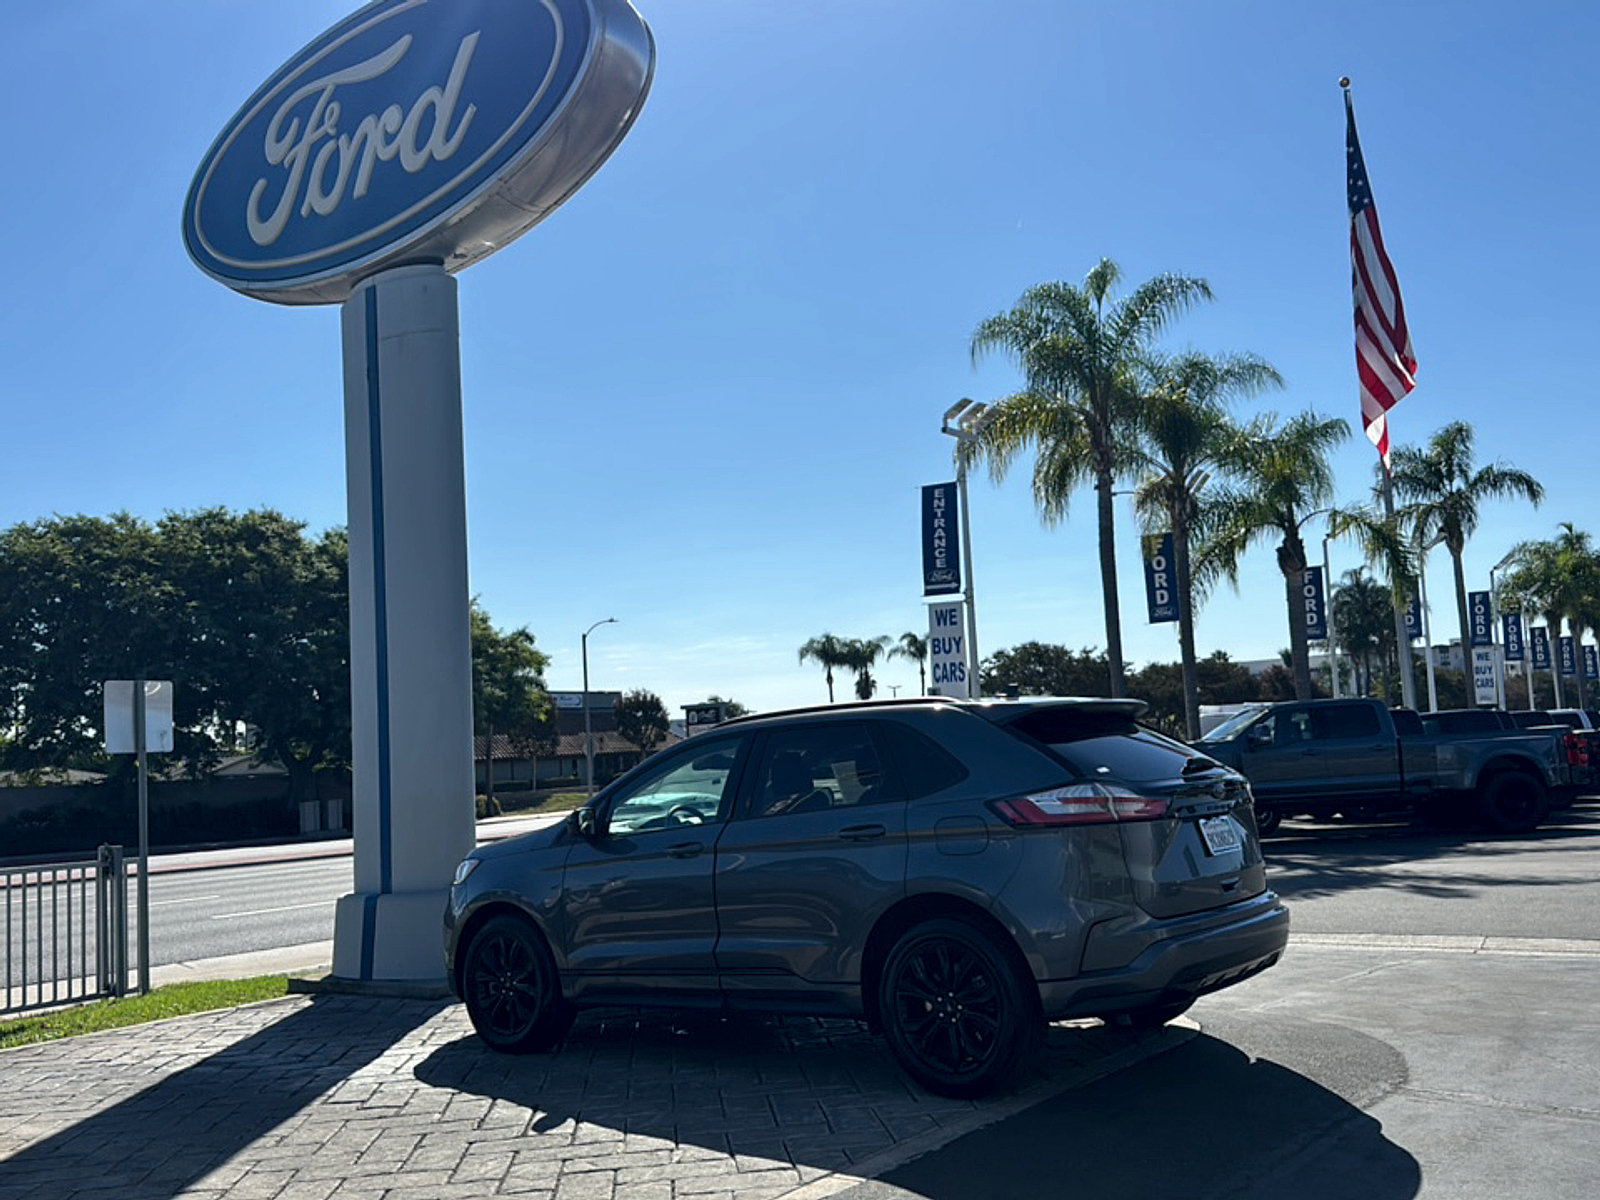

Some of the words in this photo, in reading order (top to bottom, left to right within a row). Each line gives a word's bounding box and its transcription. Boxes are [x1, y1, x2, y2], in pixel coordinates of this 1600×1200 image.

[246, 30, 481, 246] Ford
[933, 488, 947, 568] ENTRANCE
[1303, 571, 1318, 626] FORD
[935, 608, 958, 627] WE
[1474, 594, 1486, 635] FORD
[1508, 615, 1518, 651] FORD
[932, 636, 962, 655] BUY
[1476, 652, 1491, 661] WE
[933, 662, 966, 683] CARS
[1475, 666, 1493, 675] BUY
[1475, 678, 1495, 688] CARS
